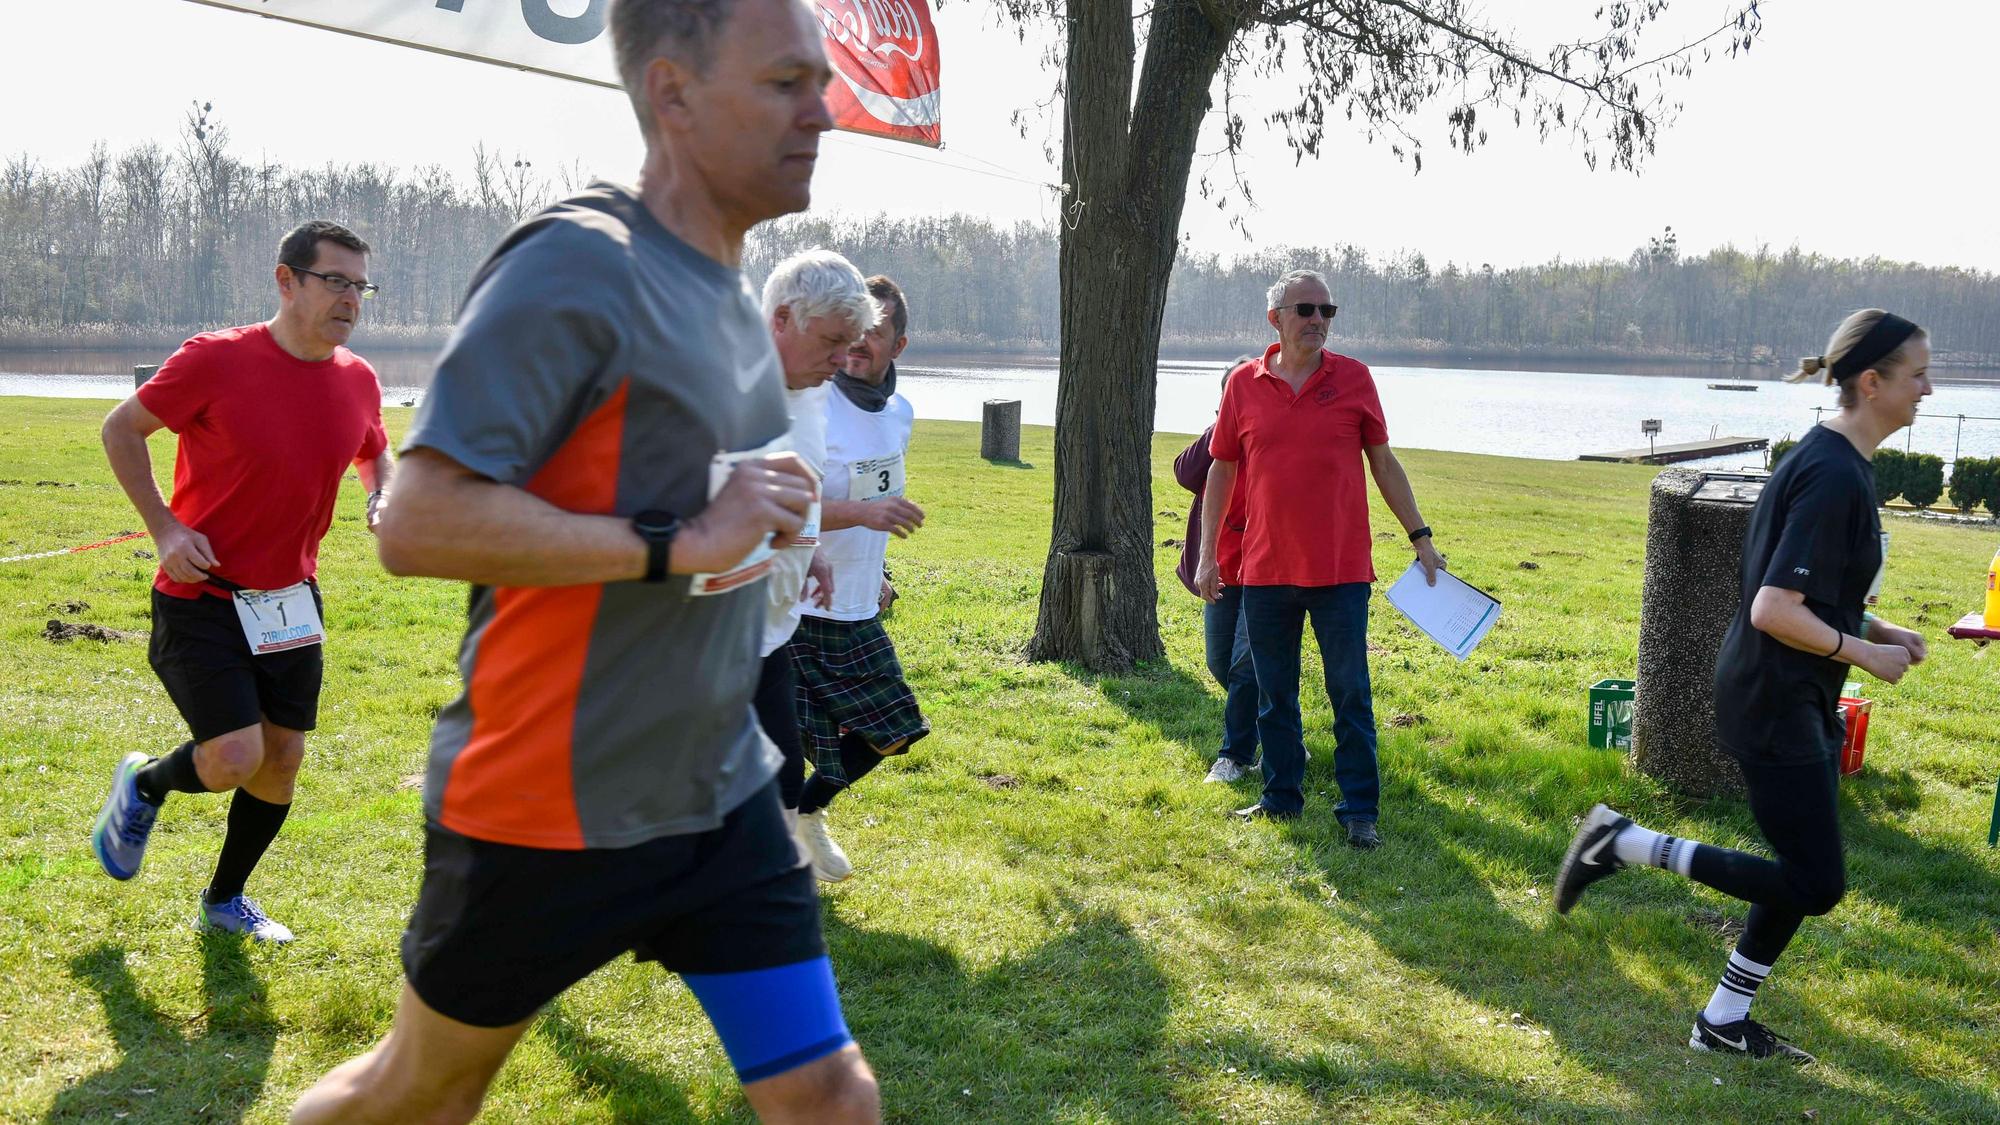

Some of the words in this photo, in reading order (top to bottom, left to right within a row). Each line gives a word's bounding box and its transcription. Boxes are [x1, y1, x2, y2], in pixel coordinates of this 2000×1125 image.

[878, 470, 890, 492] 3
[277, 602, 287, 627] 1
[1594, 700, 1604, 726] EIFEL
